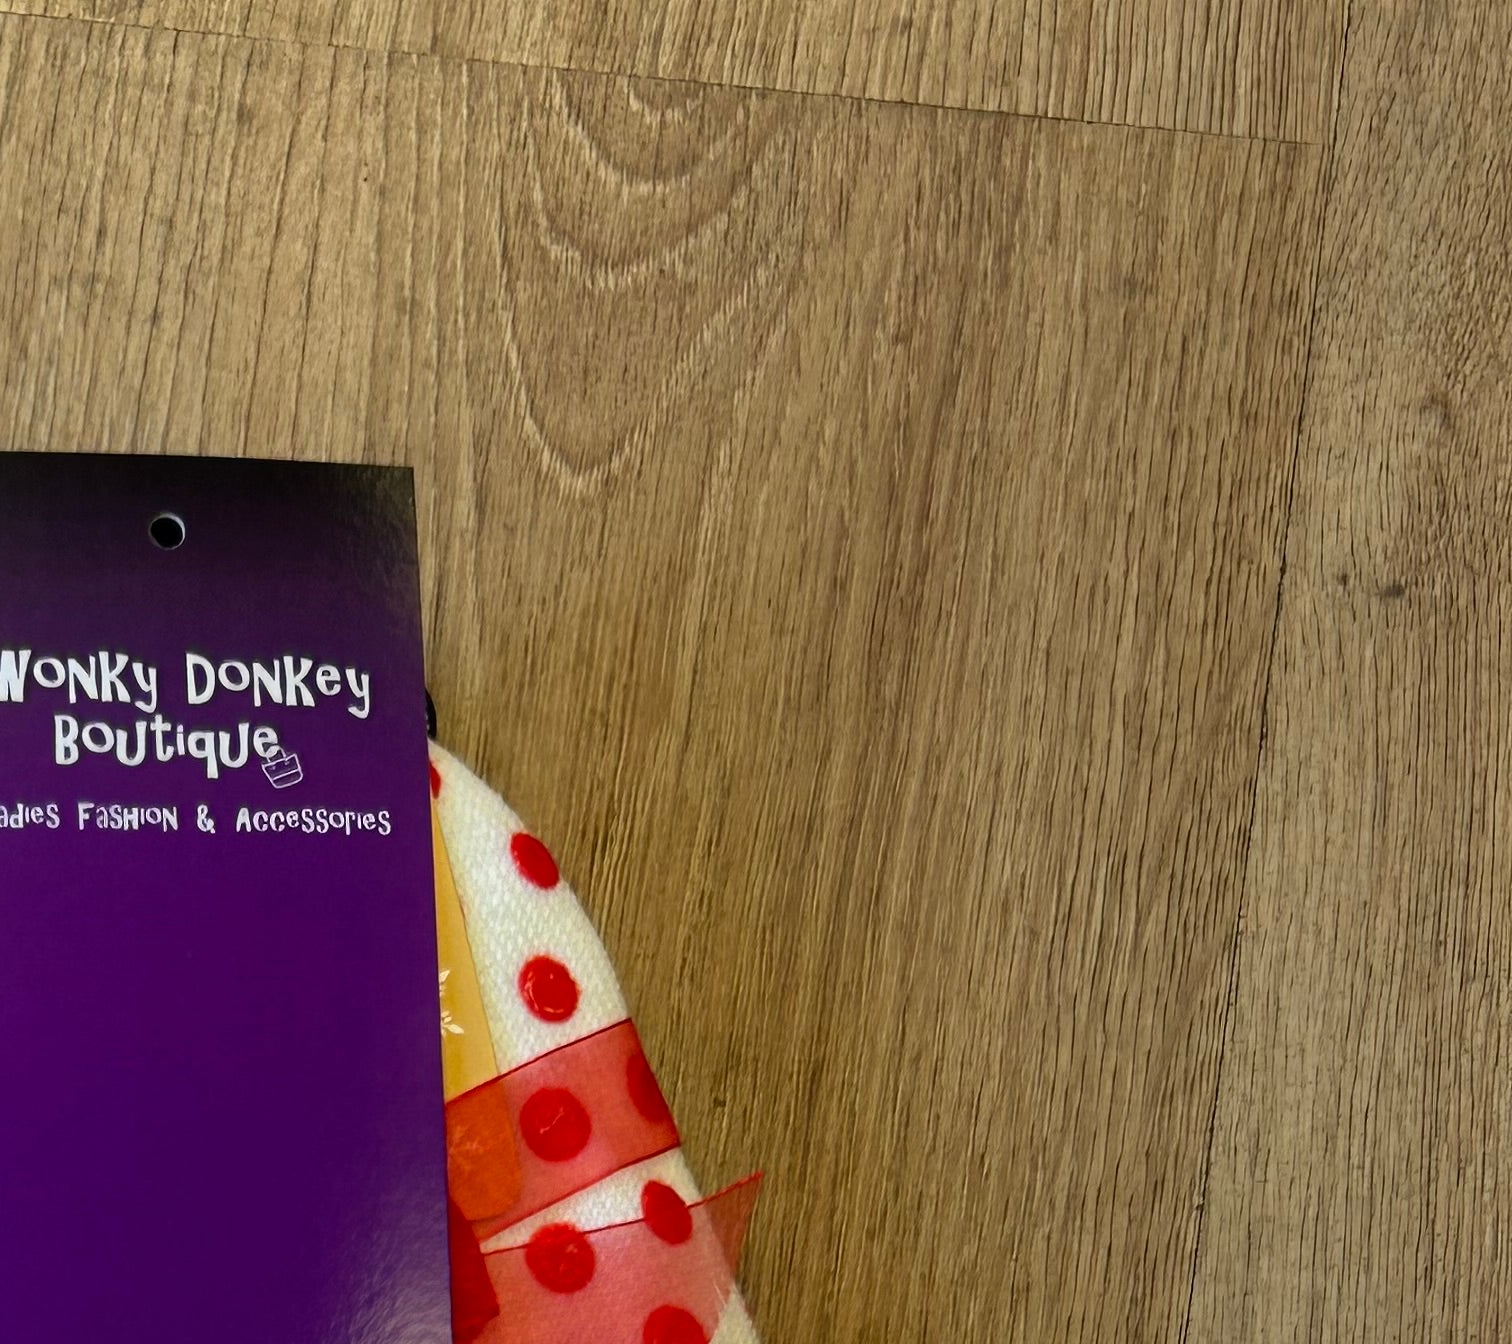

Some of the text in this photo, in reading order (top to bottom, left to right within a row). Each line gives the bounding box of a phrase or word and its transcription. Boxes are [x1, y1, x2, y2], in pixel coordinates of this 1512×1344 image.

[186, 652, 370, 719] Donkey
[54, 714, 279, 779] Boutique
[78, 803, 178, 832] Fashion
[196, 805, 216, 834] &
[236, 806, 392, 836] Accessories
